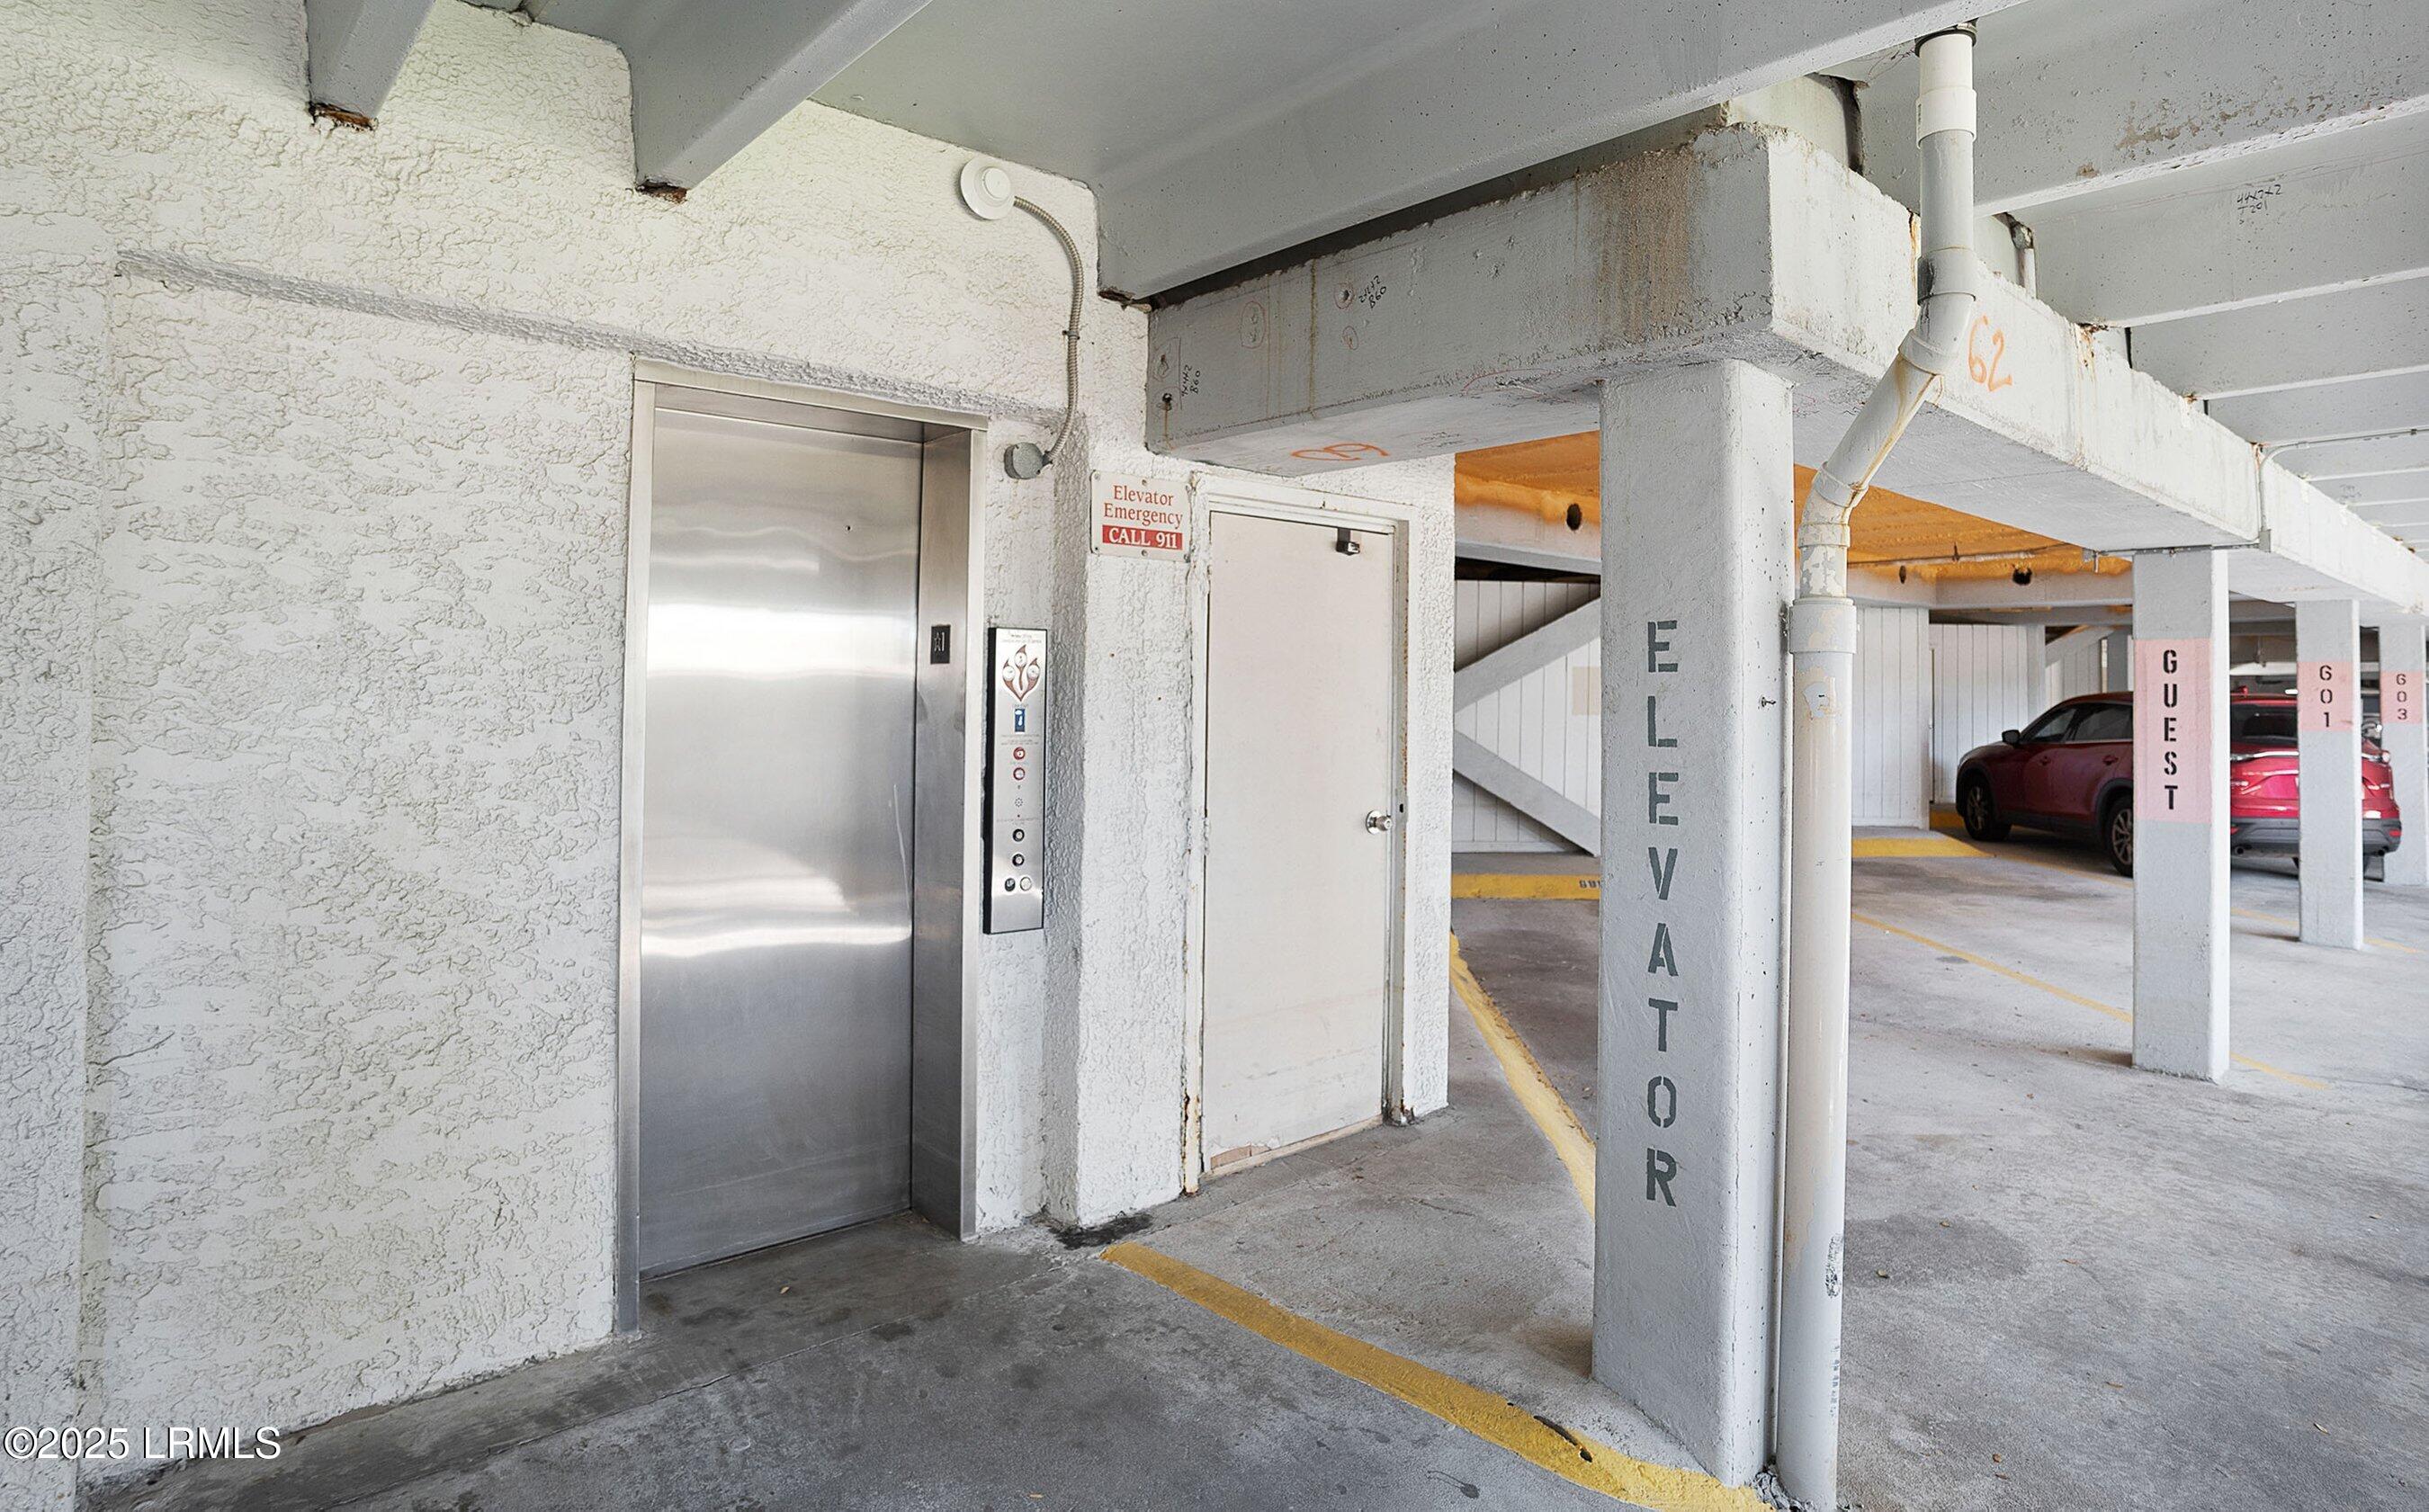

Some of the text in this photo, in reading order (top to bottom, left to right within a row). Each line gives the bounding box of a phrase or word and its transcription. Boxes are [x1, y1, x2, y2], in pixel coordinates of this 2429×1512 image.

[1967, 315, 2013, 391] 62
[1103, 502, 1183, 529] Emergency
[1113, 484, 1174, 506] Elevator
[1108, 527, 1178, 549] CALL 911
[2319, 665, 2333, 728] 601
[2396, 674, 2407, 720] 603
[2163, 649, 2178, 810] GUEST
[1645, 620, 1679, 1208] ELEVATOR
